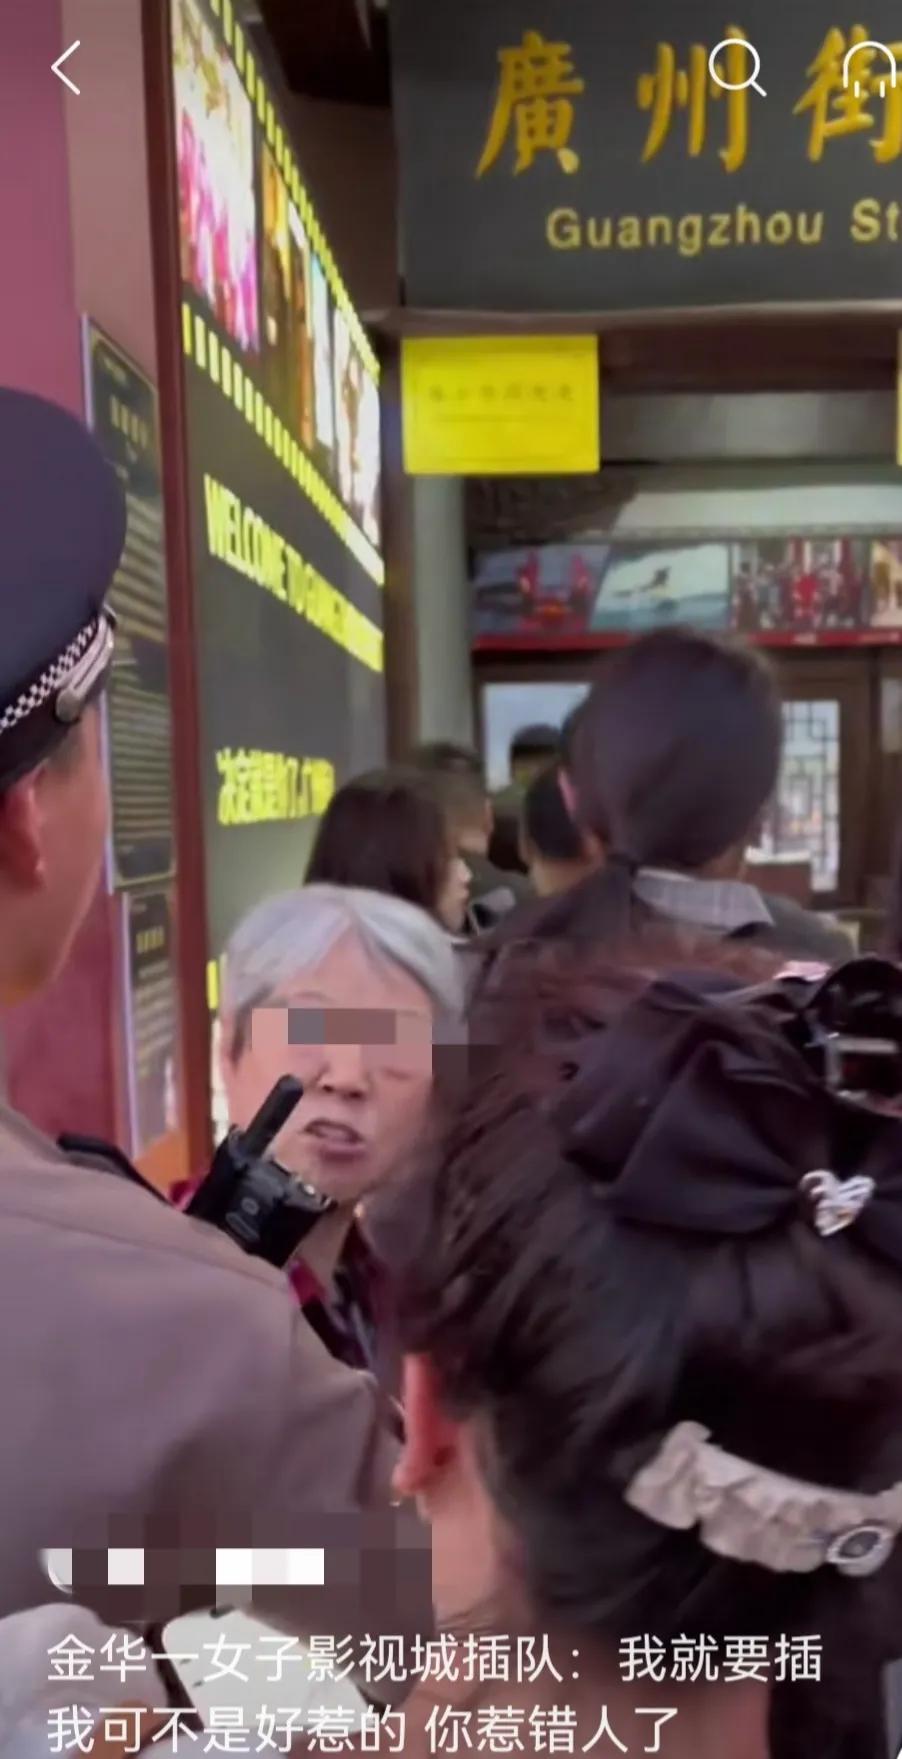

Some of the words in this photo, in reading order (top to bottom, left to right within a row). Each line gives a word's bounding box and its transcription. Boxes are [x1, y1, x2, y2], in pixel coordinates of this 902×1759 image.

[475, 23, 902, 180] 廣州街
[546, 205, 824, 256] Guangzhou
